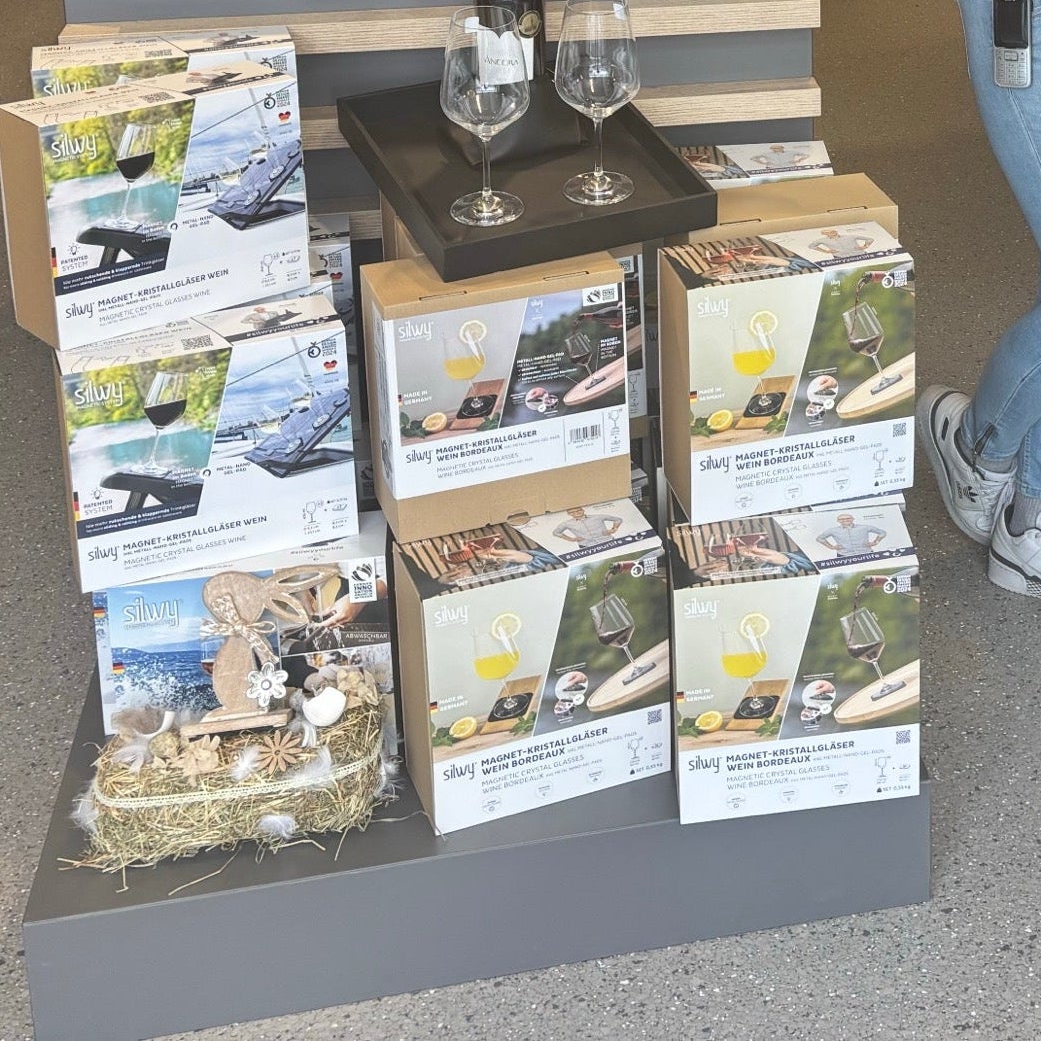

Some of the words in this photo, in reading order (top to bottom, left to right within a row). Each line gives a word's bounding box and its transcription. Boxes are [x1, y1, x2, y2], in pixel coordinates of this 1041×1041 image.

[51, 133, 97, 160] silwy
[61, 255, 88, 265] PATENTED
[62, 261, 88, 271] SYSTEM
[66, 303, 93, 318] silwy
[98, 275, 206, 307] MAGNET-KRISTALLGLÄSER
[208, 269, 229, 280] WEIN
[164, 295, 192, 308] GLASSES
[194, 289, 211, 298] WINE
[697, 296, 729, 317] silwy
[398, 321, 432, 341] silwy
[74, 380, 123, 406] silwy
[406, 449, 431, 464] silwy
[436, 430, 537, 454] MAGNET-KRISTALLGLÄSER
[437, 451, 459, 462] WEIN
[460, 444, 504, 458] BORDEAUX
[700, 455, 729, 473] silwy
[735, 435, 855, 462] MAGNET-KRISTALLGLÄSER
[735, 470, 770, 482] MAGNETIC
[772, 465, 801, 476] CRYSTAL
[802, 460, 832, 471] GLASSES
[736, 461, 762, 471] WEIN
[764, 451, 815, 466] BORDEAUX
[736, 480, 754, 489] WINE
[756, 474, 794, 486] BORDEAUX
[83, 499, 112, 509] PATENTED
[84, 504, 113, 515] SYSTEM
[88, 544, 118, 562] silwy
[123, 520, 241, 550] MAGNET-KRISTALLGLÄSER
[243, 515, 267, 526] WEIN
[124, 553, 162, 566] MAGNETIC
[163, 545, 195, 559] CRYSTAL
[196, 540, 227, 552] GLASSES
[228, 535, 247, 544] WINE
[122, 597, 180, 626] silwy
[434, 605, 468, 624] silwy
[684, 598, 717, 619] silwy
[443, 762, 475, 781] silwy
[481, 727, 608, 767] MAGNET-KRISTALLGLÄSER
[482, 764, 510, 776] WEIN
[512, 748, 565, 767] BORDEAUX
[688, 755, 720, 773] silwy
[726, 740, 855, 764] MAGNET-KRISTALLGLÄSER
[727, 761, 754, 772] WEIN
[757, 755, 811, 768] BORDEAUX
[481, 773, 519, 787] MAGNETIC
[521, 765, 551, 778] CRYSTAL
[553, 755, 584, 769] GLASSES
[726, 773, 764, 783] MAGNETIC
[766, 768, 797, 779] CRYSTAL
[799, 765, 830, 774] GLASSES
[482, 784, 502, 794] WINE
[504, 773, 544, 789] BORDEAUX
[727, 782, 747, 791] WINE
[748, 777, 789, 788] BORDEAUX
